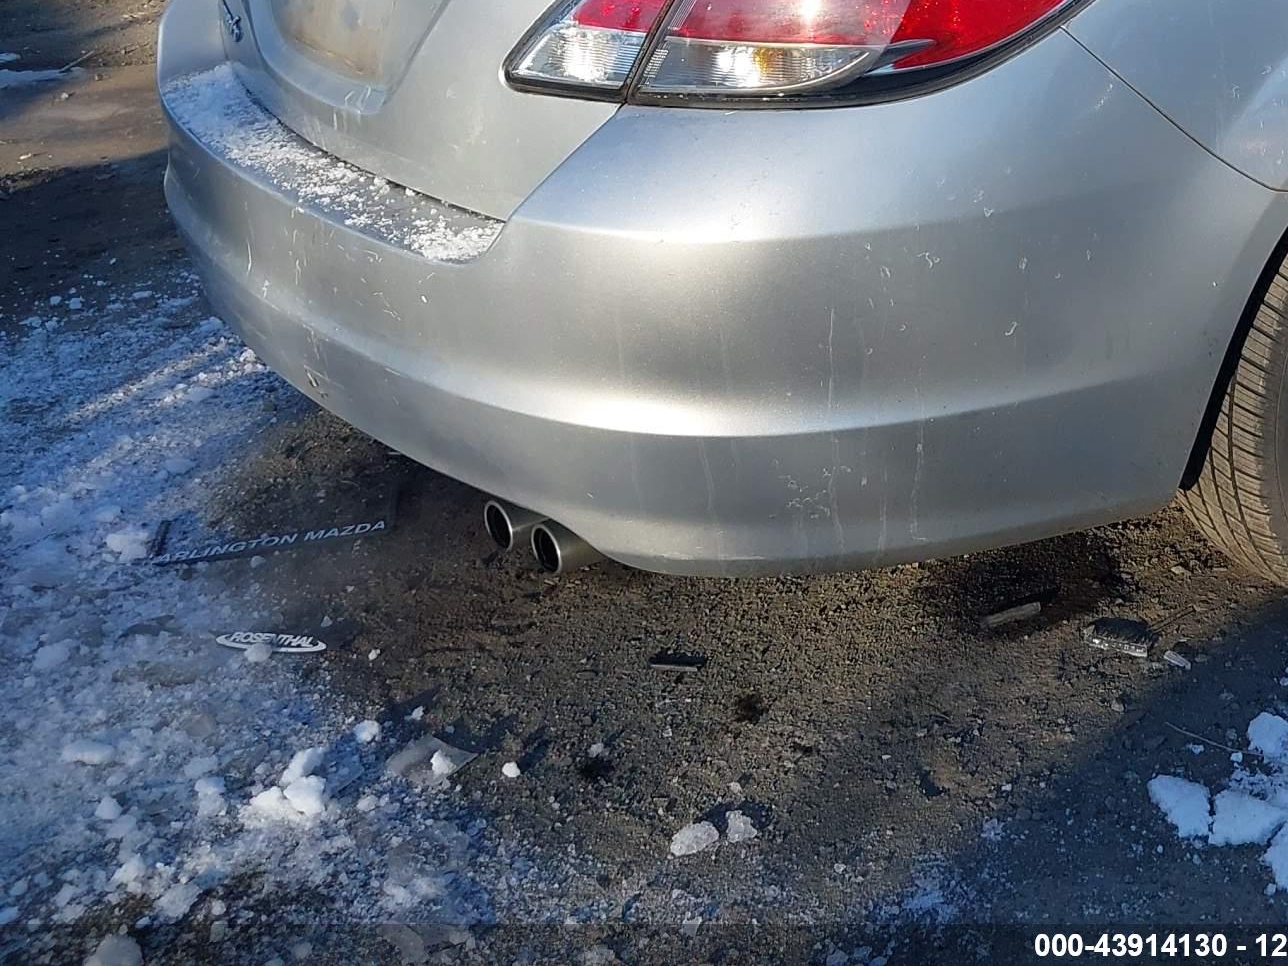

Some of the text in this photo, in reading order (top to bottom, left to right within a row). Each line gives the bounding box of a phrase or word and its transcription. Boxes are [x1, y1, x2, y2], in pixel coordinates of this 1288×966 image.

[158, 520, 385, 563] ARLINGTON MAZDA
[229, 632, 314, 647] ROSENTHAL
